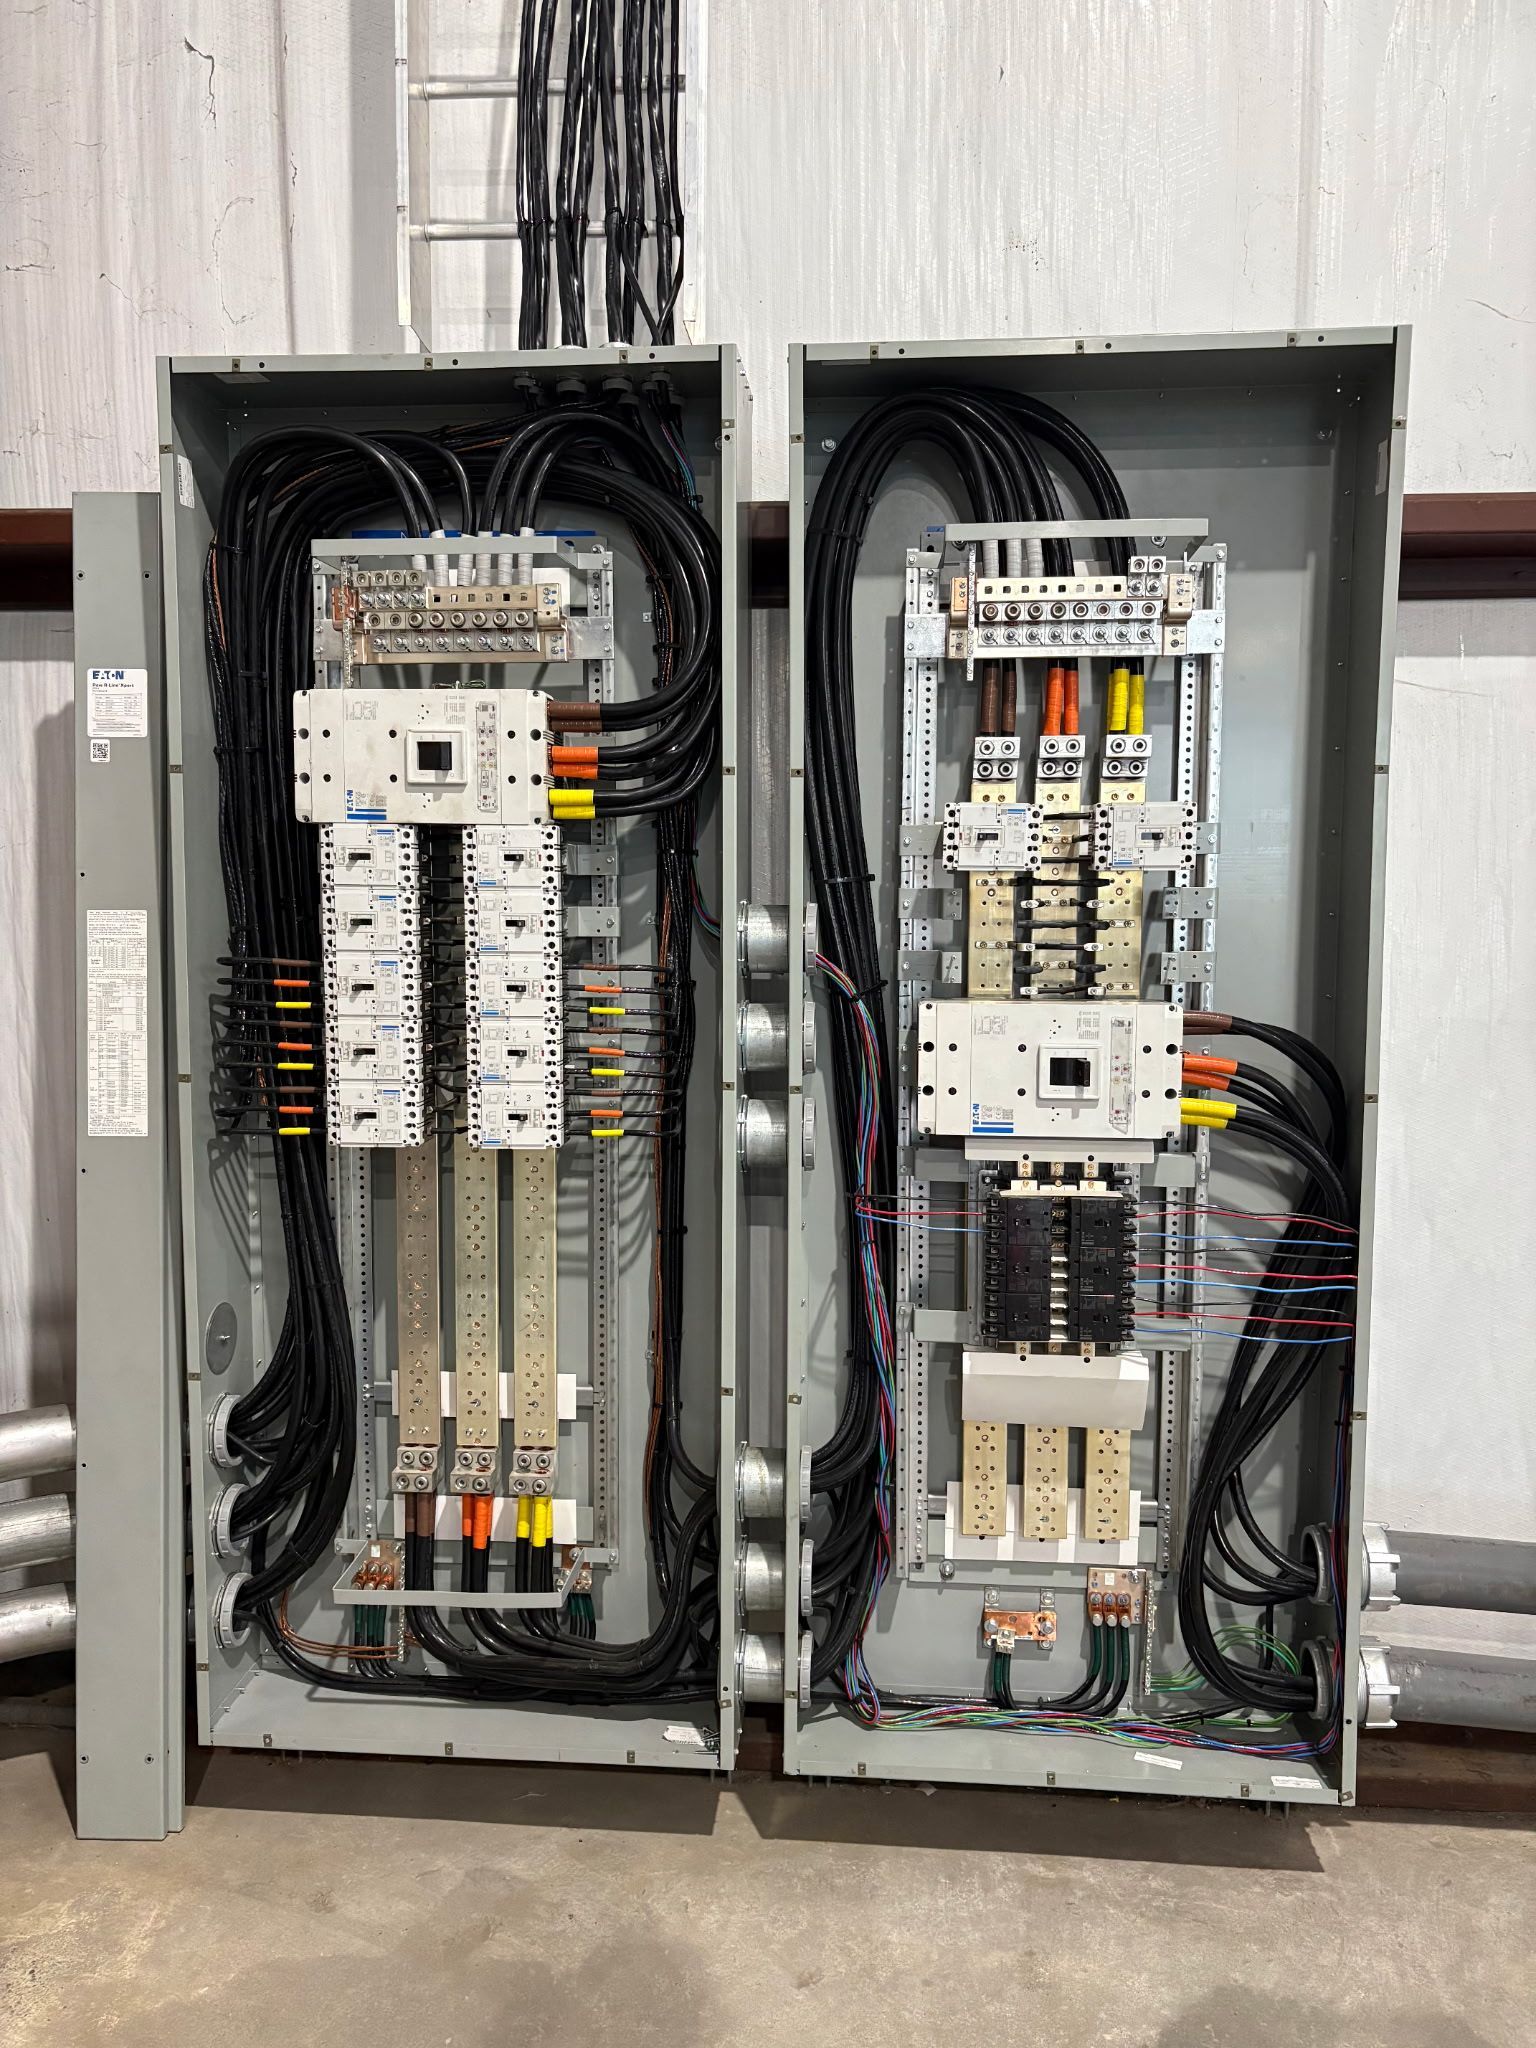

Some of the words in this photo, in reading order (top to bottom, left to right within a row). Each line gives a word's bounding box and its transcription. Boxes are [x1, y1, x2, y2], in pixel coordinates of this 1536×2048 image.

[354, 964, 360, 972] 5
[523, 965, 529, 974] 2
[524, 1029, 531, 1038] 1
[526, 1094, 532, 1102] 3
